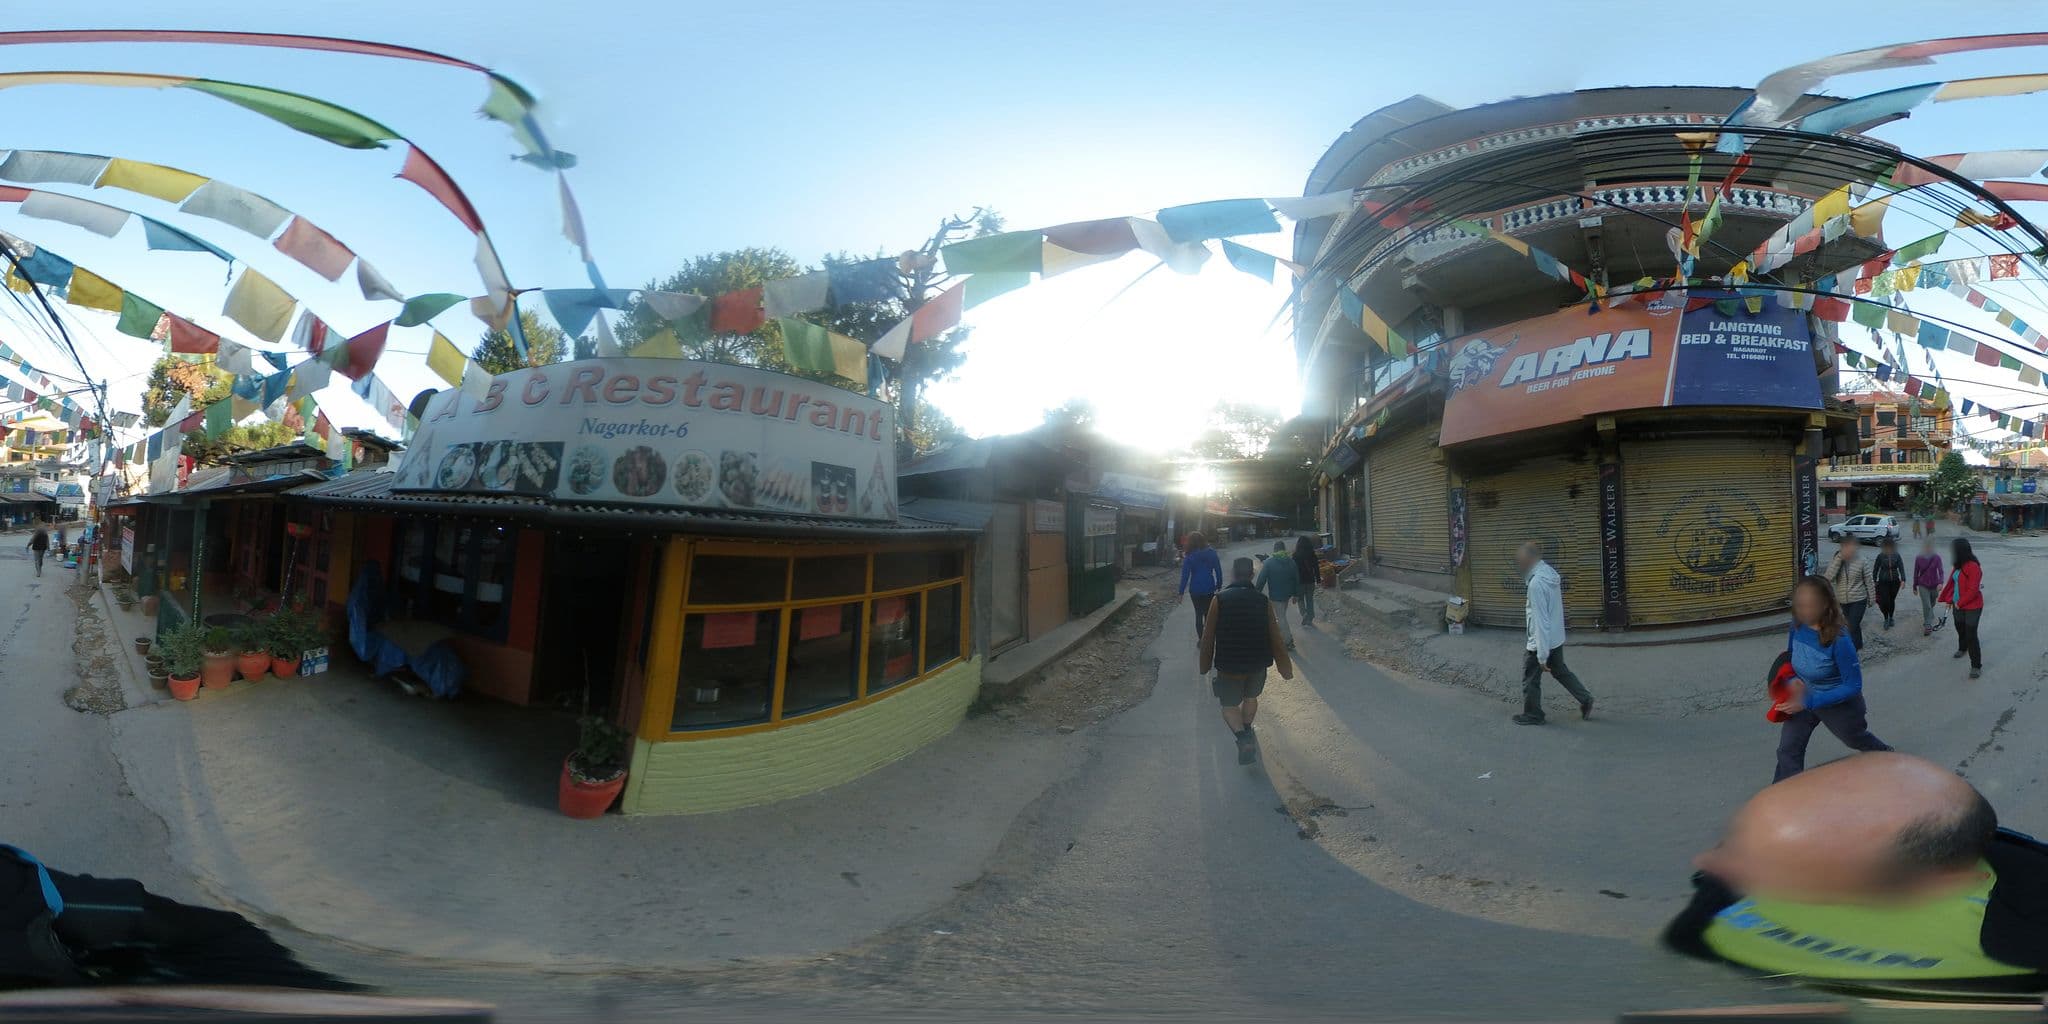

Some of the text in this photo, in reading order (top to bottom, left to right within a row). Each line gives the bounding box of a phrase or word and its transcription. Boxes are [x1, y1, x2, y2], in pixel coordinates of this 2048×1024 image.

[1681, 333, 1809, 351] BED & BREAKFAST
[1709, 321, 1782, 336] LANGTANG
[1500, 328, 1651, 387] ARNA
[1526, 381, 1550, 394] BEER
[1552, 377, 1570, 390] FOR
[559, 366, 885, 441] Restaurant
[578, 417, 689, 438] Nagarkot-6
[1802, 475, 1811, 524] WALKER
[1606, 484, 1621, 607] JOHNNIE WALKER
